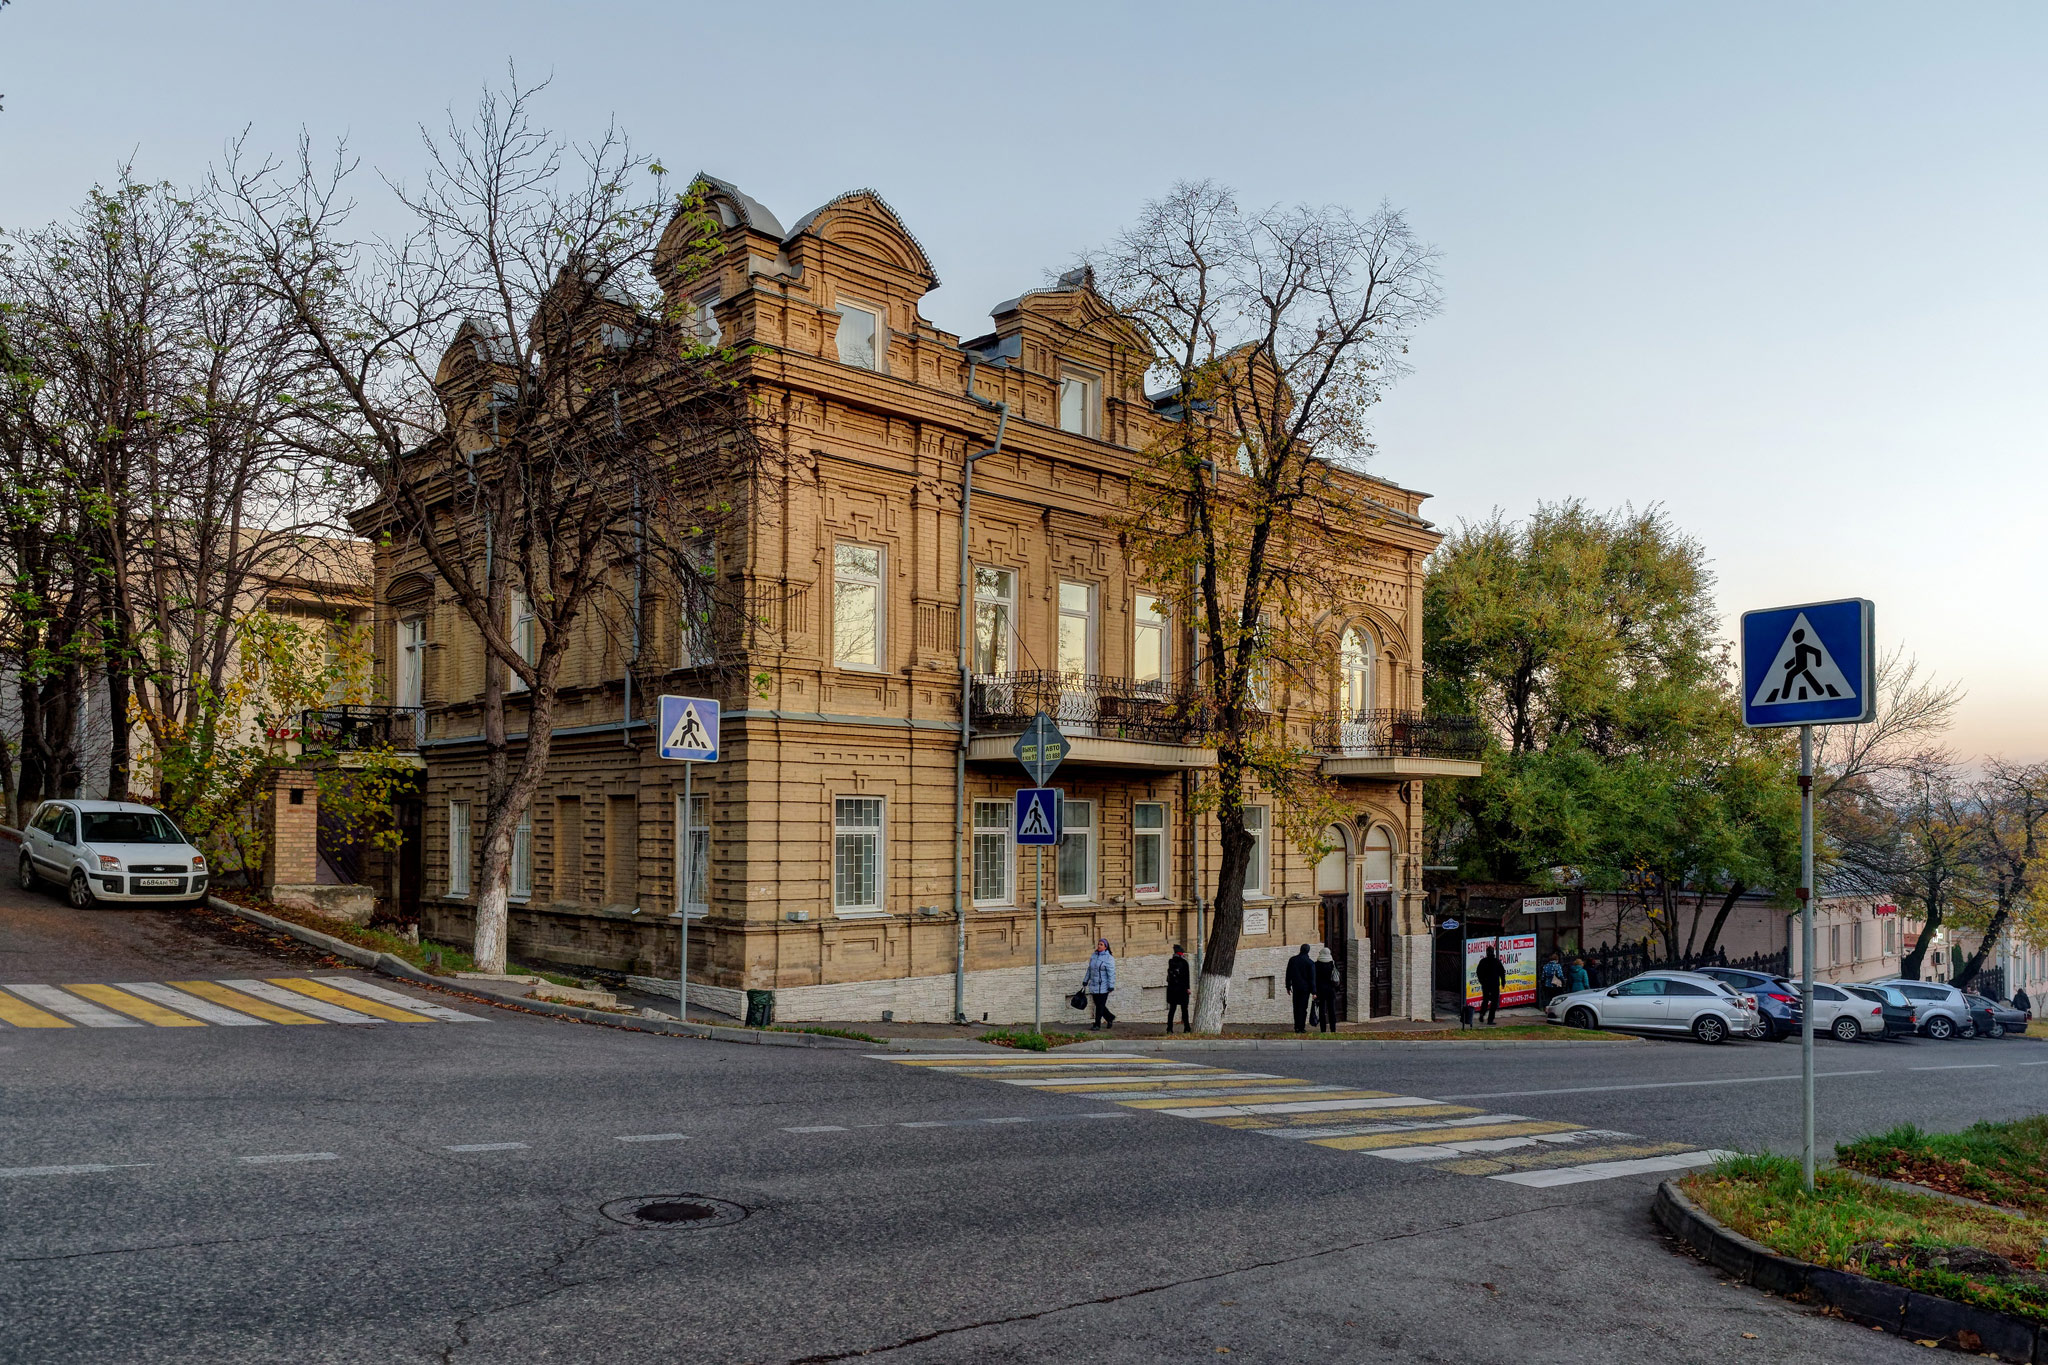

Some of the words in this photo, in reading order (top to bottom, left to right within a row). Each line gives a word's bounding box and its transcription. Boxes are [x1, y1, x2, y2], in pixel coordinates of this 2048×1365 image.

[1524, 898, 1555, 907] БАНКЕТНЫЙ
[1556, 897, 1566, 906] ЗАЛ
[1499, 939, 1512, 951] ЗАЛ
